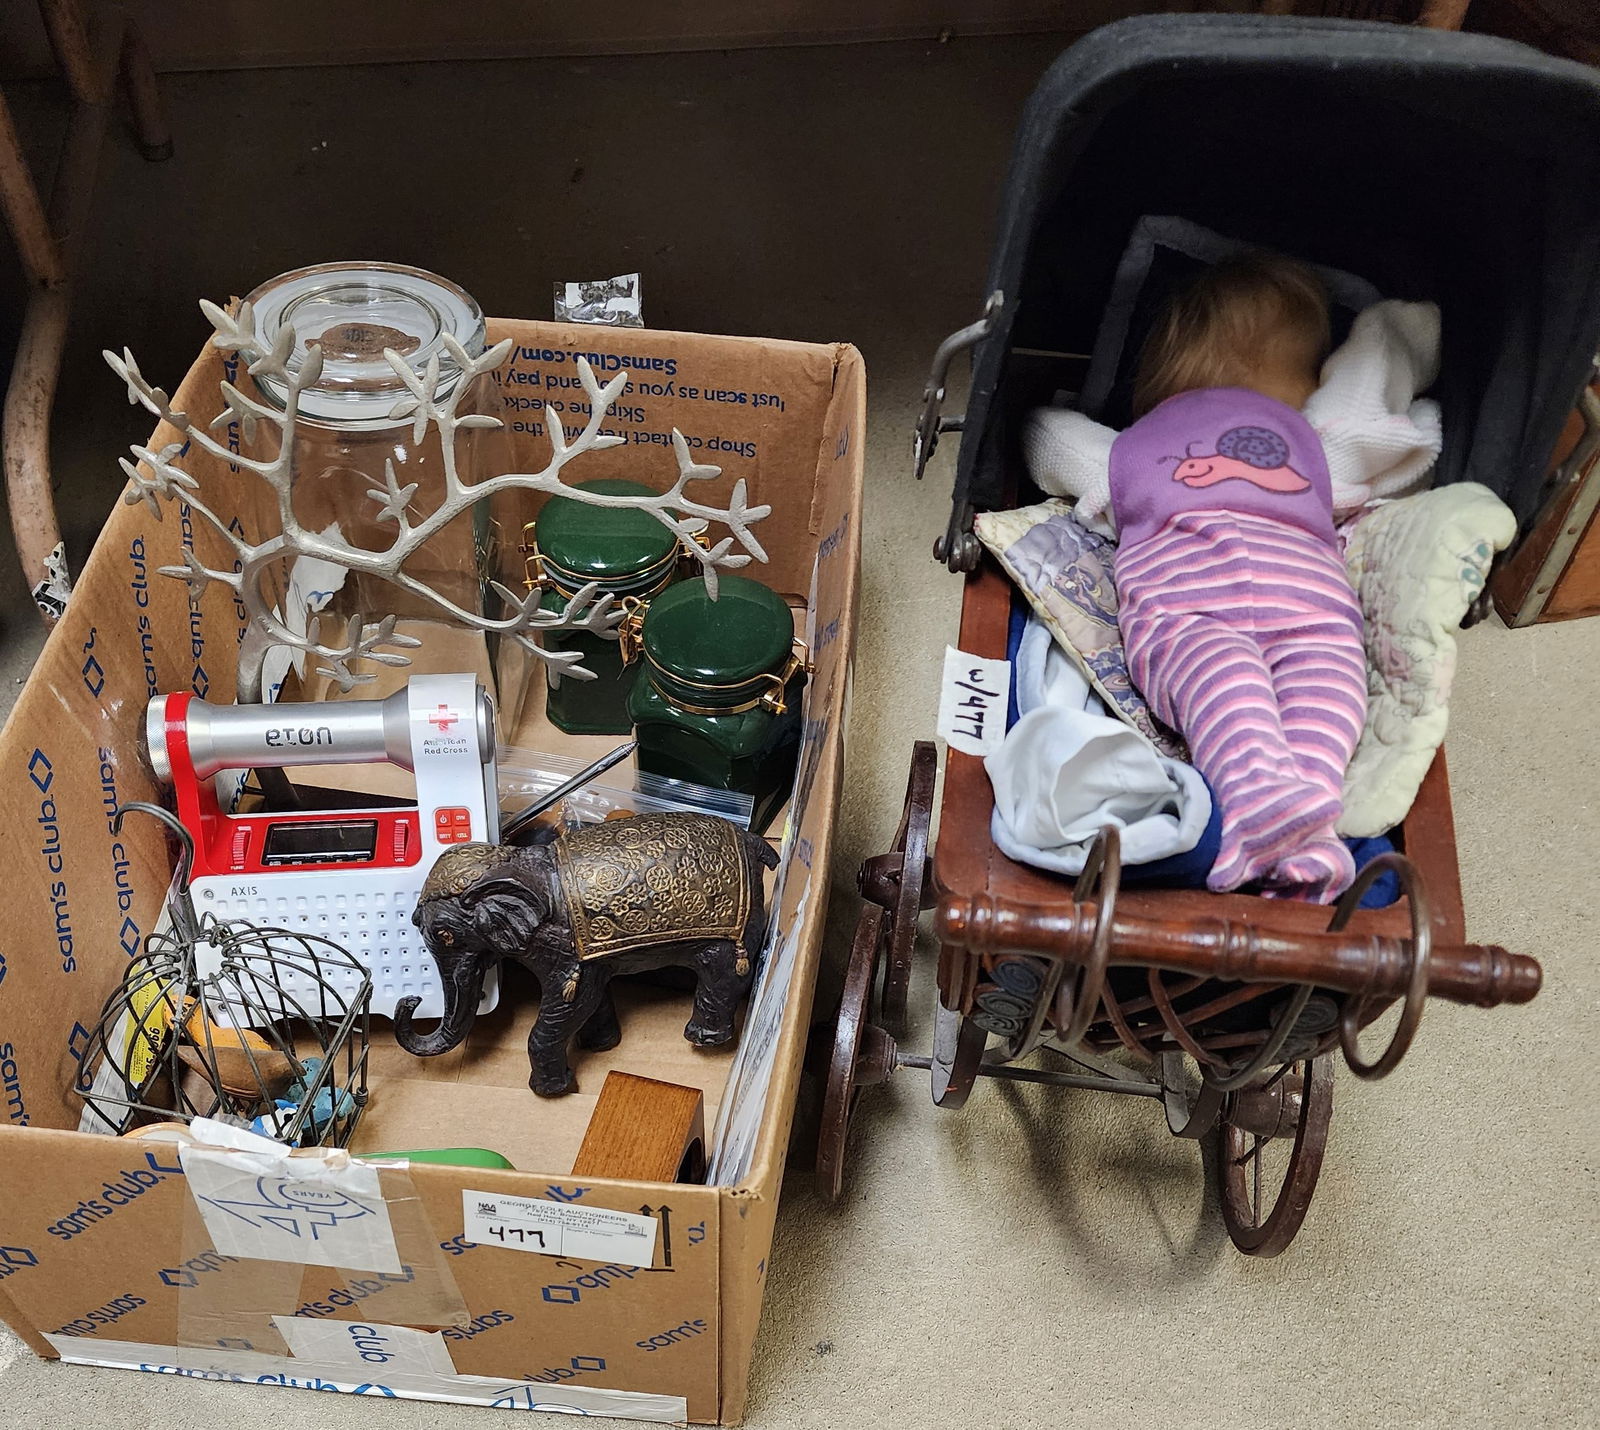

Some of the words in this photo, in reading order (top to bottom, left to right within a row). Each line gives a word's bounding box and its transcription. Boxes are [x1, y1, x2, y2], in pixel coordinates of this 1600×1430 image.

[506, 369, 541, 387] pay
[546, 375, 582, 391] and
[639, 381, 675, 398] you
[679, 387, 699, 401] as
[704, 389, 748, 405] scan
[605, 401, 645, 423] Skip
[513, 422, 544, 437] the
[634, 431, 703, 448] cotact
[708, 436, 757, 458] Shop
[130, 538, 149, 607] club
[138, 615, 158, 697] sam's
[424, 747, 441, 755] Red
[443, 747, 468, 755] Cross
[37, 799, 62, 875] club
[111, 843, 134, 911] club
[231, 886, 258, 897] AXIS
[49, 880, 76, 974] sam's
[0, 1042, 29, 1126] sam'
[47, 1199, 114, 1240] sam's
[102, 1170, 160, 1207] club
[291, 1189, 332, 1200] YEARS
[500, 1200, 537, 1210] GEORGE
[565, 1208, 628, 1222] AUCTIONEERS
[489, 1225, 546, 1249] 477
[327, 1279, 385, 1307] club
[86, 1293, 147, 1324] sam's
[51, 1319, 98, 1338] clu
[635, 1319, 707, 1352] sam's
[348, 1325, 396, 1363] club
[522, 1367, 576, 1384] lub
